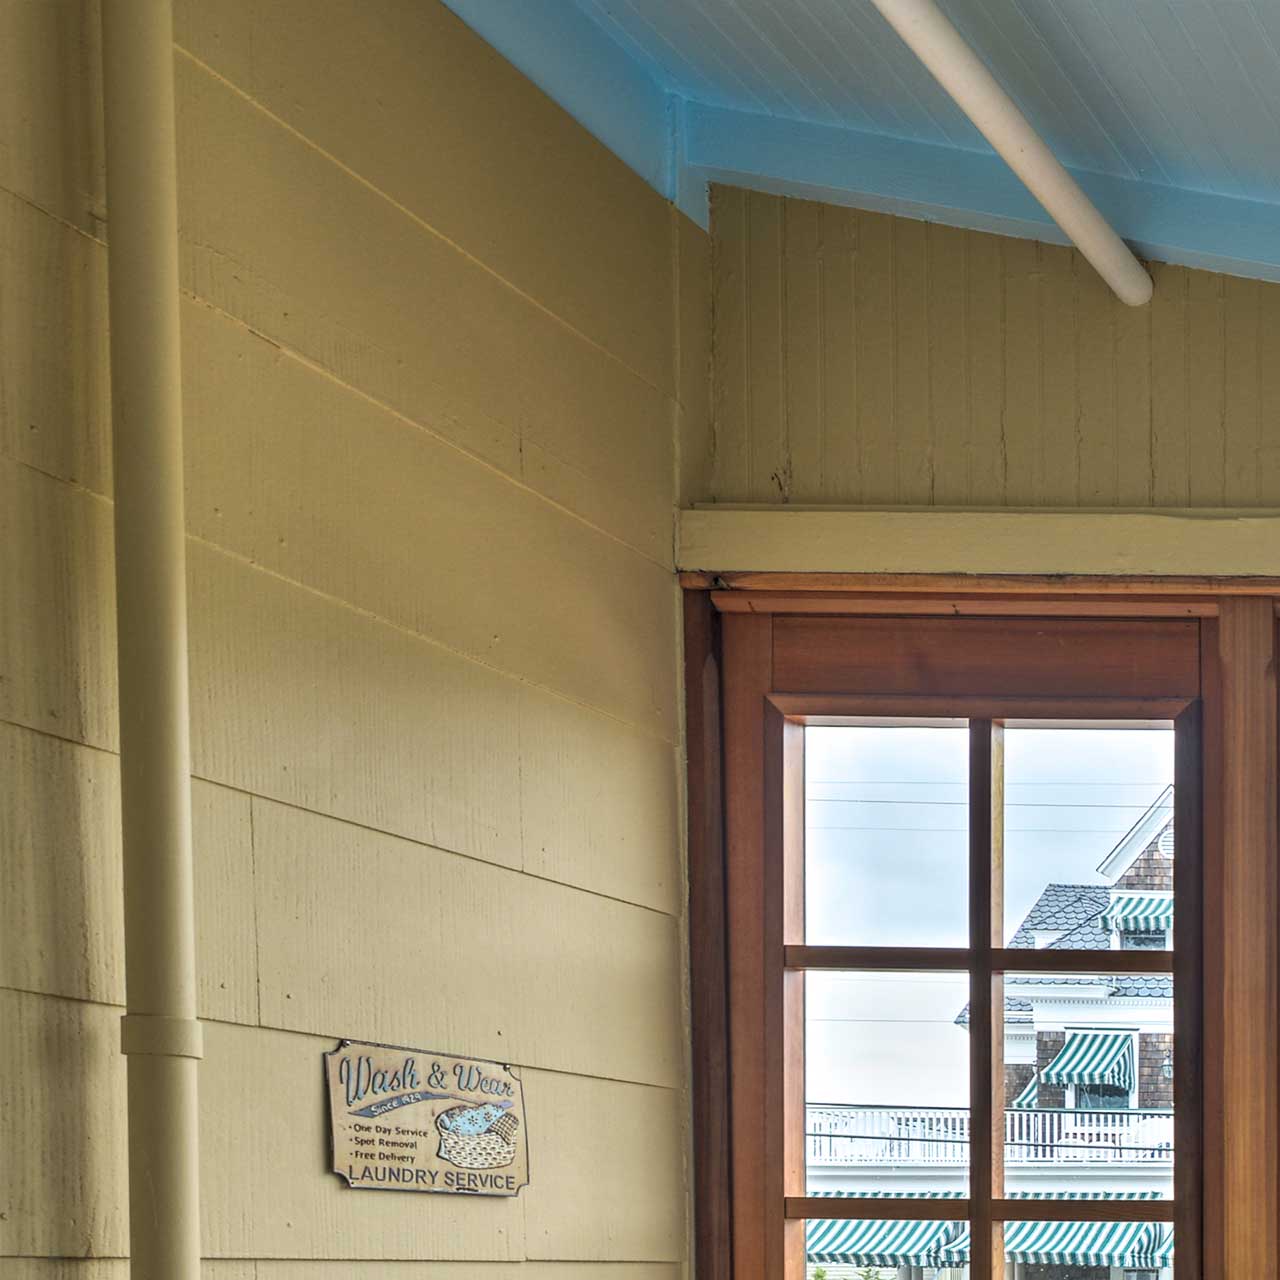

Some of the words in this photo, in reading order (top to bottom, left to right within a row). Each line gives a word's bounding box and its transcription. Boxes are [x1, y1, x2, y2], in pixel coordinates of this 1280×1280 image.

[339, 1056, 420, 1107] Wash
[427, 1062, 448, 1089] &
[453, 1063, 514, 1097] Wear
[370, 1099, 399, 1116] Since
[354, 1123, 372, 1133] One
[375, 1125, 392, 1136] Day
[395, 1127, 428, 1138] Service
[354, 1136, 375, 1147] Spot
[378, 1138, 418, 1150] Removal
[355, 1150, 376, 1160] Free
[378, 1152, 416, 1165] Delivery
[349, 1164, 439, 1185] LAUNDRY
[444, 1172, 515, 1191] SERVICE
